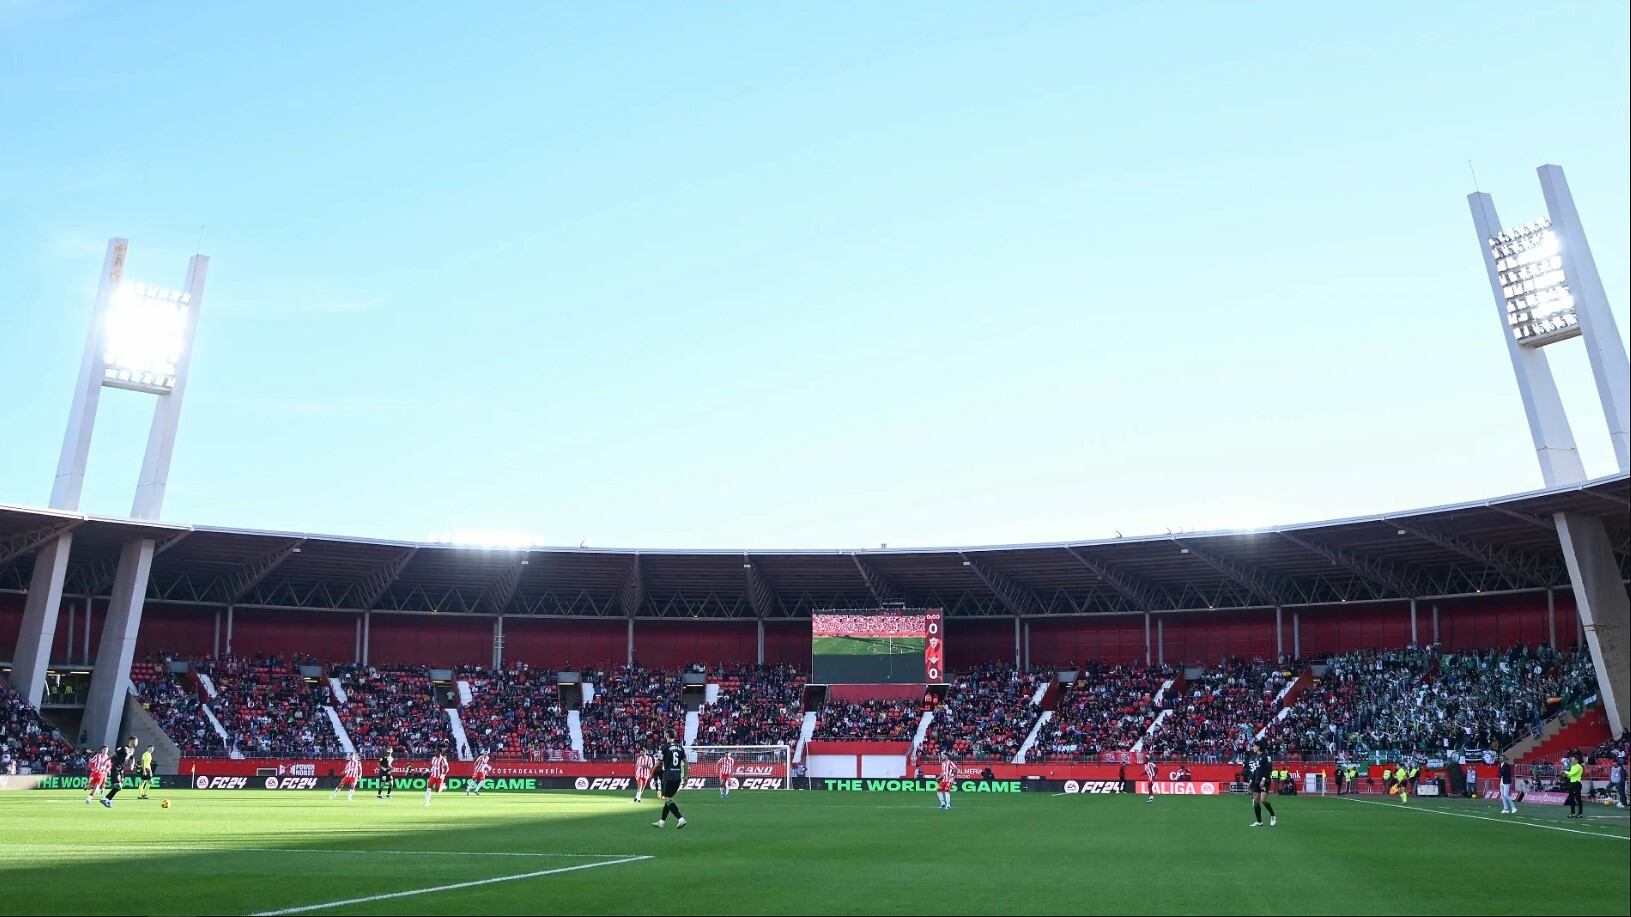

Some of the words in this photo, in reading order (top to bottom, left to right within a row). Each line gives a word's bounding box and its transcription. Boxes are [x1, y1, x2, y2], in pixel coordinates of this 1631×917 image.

[929, 623, 937, 634] 0
[929, 668, 937, 679] 0
[672, 751, 679, 766] 6
[209, 777, 247, 788] FC24
[279, 777, 318, 789] FC24
[483, 778, 537, 790] GAME
[590, 778, 630, 790] FC24
[825, 780, 862, 791] THE
[962, 781, 1021, 792] GAME
[1141, 782, 1196, 794] LALIGA
